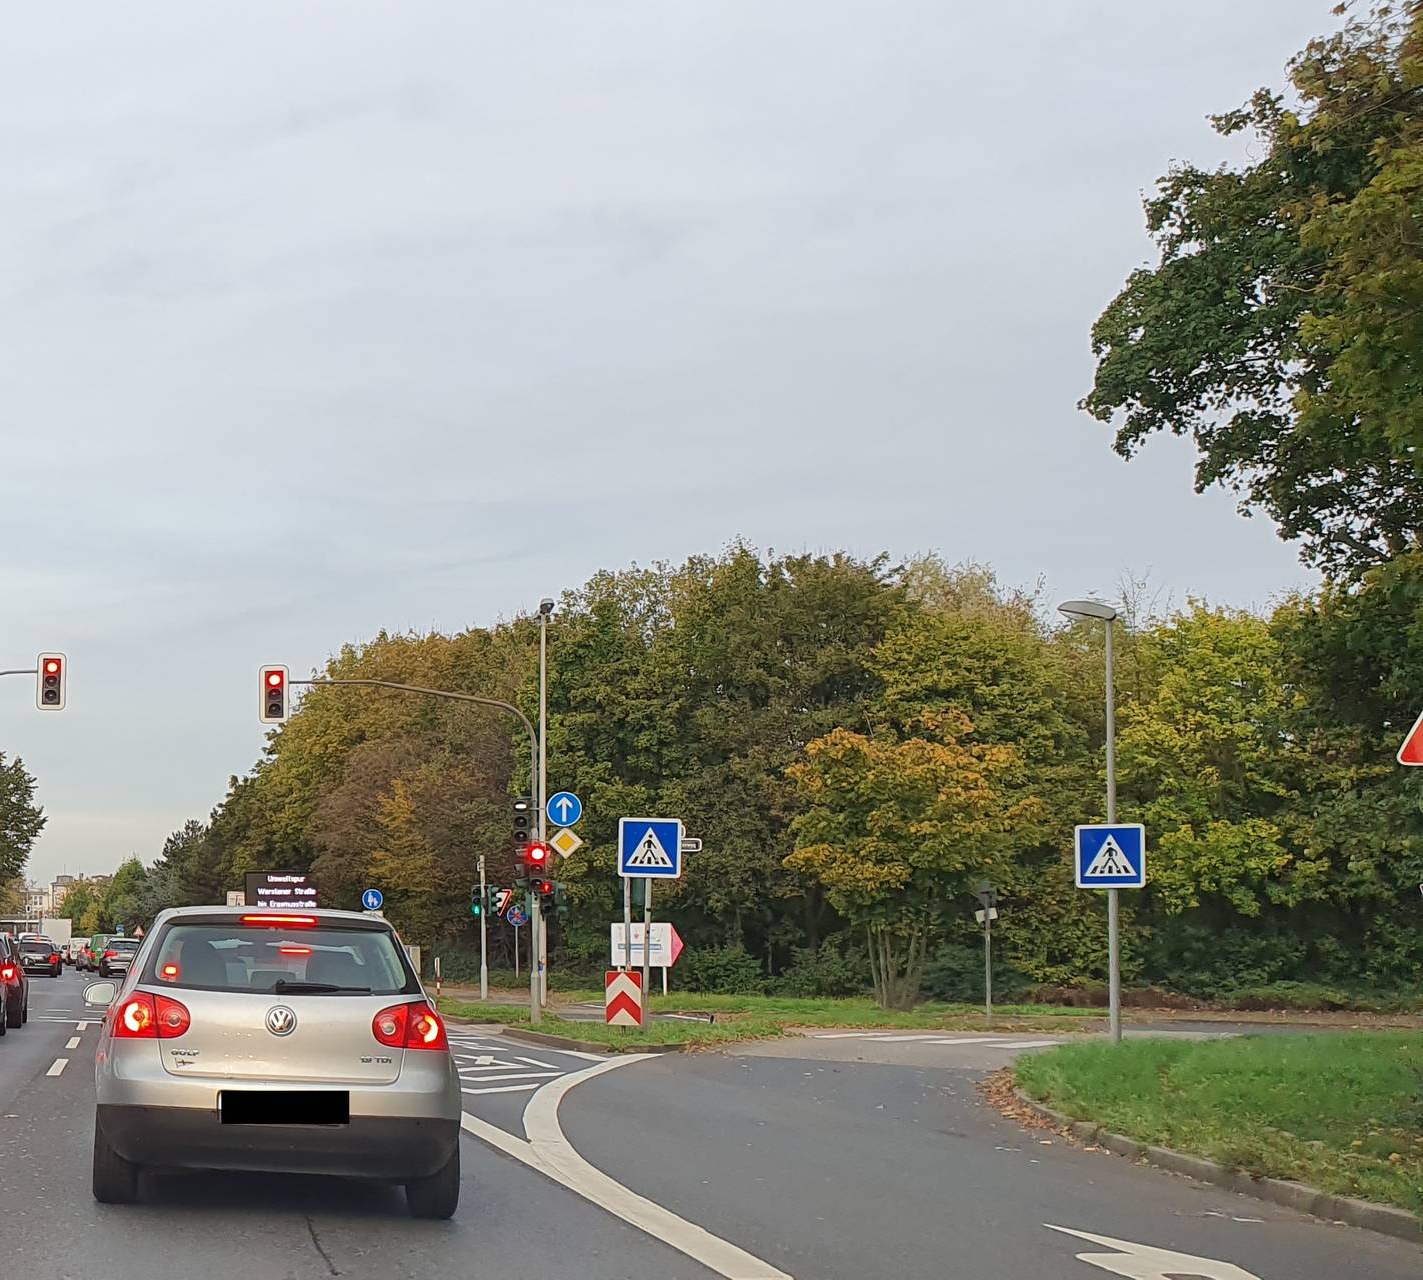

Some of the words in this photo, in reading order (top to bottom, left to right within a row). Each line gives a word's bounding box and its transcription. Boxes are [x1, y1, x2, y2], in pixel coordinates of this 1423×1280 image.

[267, 875, 305, 883] Umweltspur
[294, 887, 317, 895] Straße
[269, 900, 317, 908] Erasmusstraße
[171, 1048, 200, 1056] GOLF
